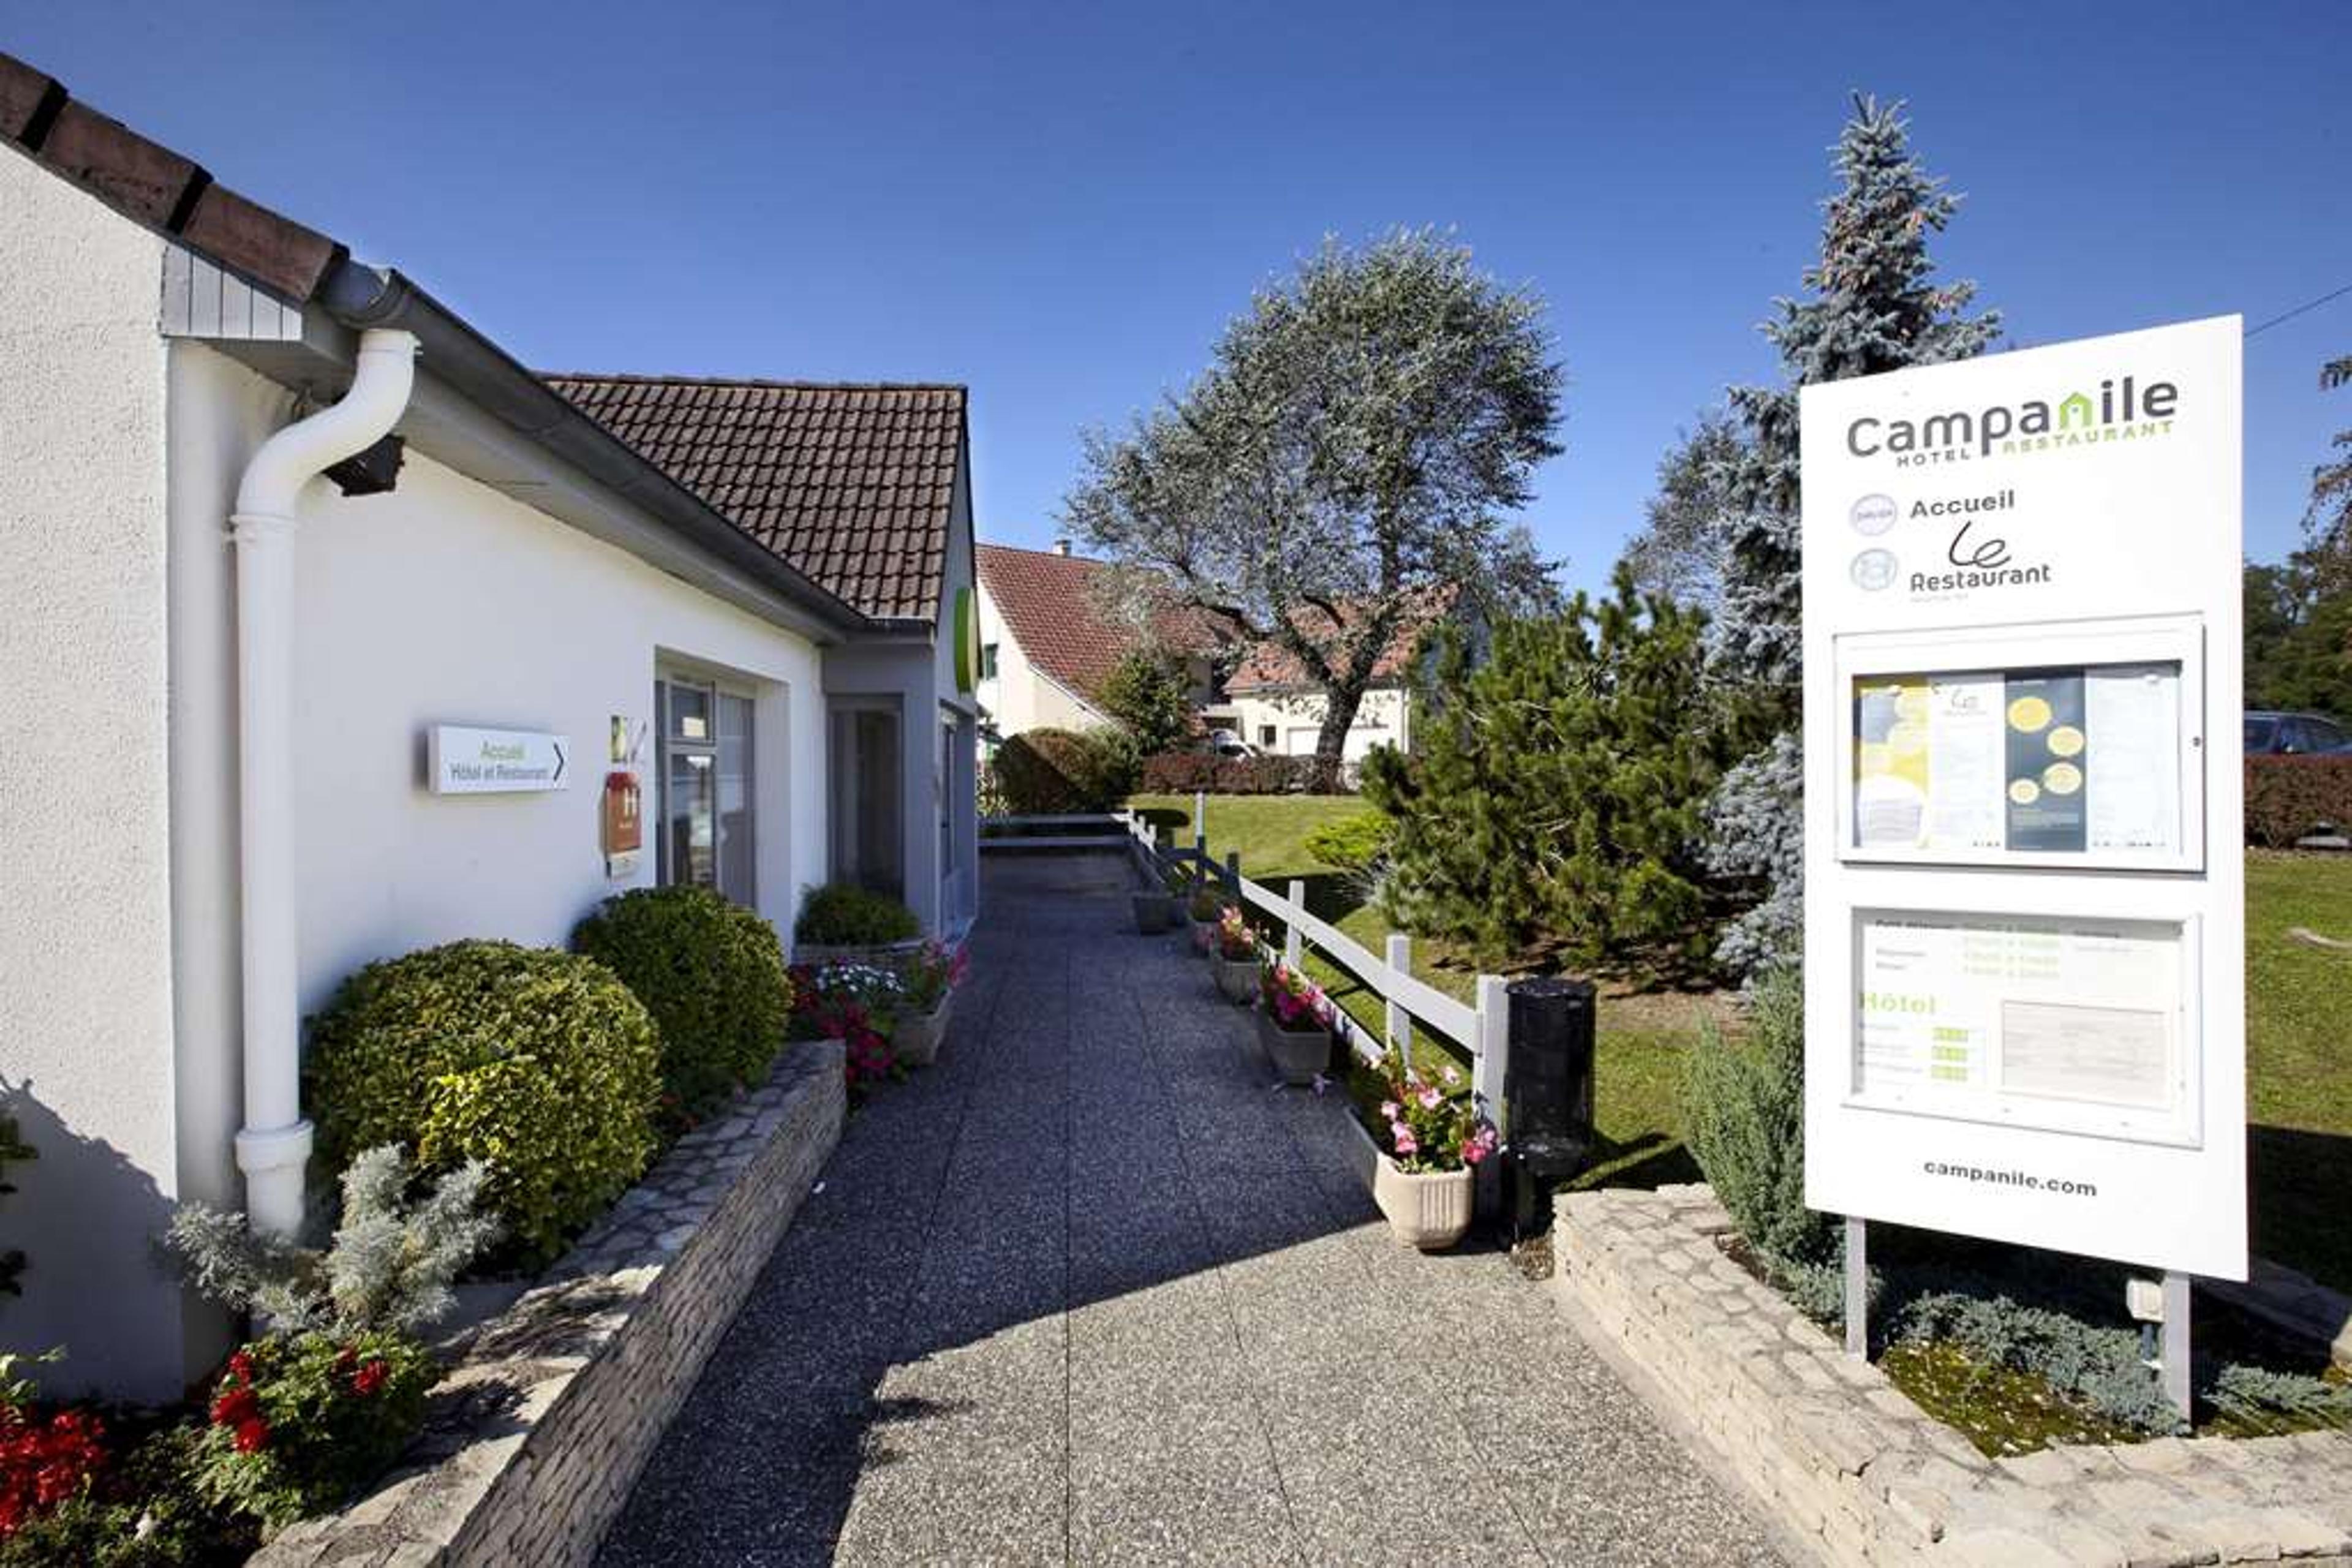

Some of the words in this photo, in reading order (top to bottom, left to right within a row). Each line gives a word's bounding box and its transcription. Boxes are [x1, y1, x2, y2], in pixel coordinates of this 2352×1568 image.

[1847, 377, 2178, 458] Campanile
[1897, 449, 1971, 468] HOTEL
[2003, 420, 2175, 454] RESTAURANT
[1910, 489, 2015, 519] Accueil
[1948, 520, 2013, 570] Le
[1910, 564, 2052, 593] Restaurant
[1924, 1159, 2098, 1197] campanile.com
